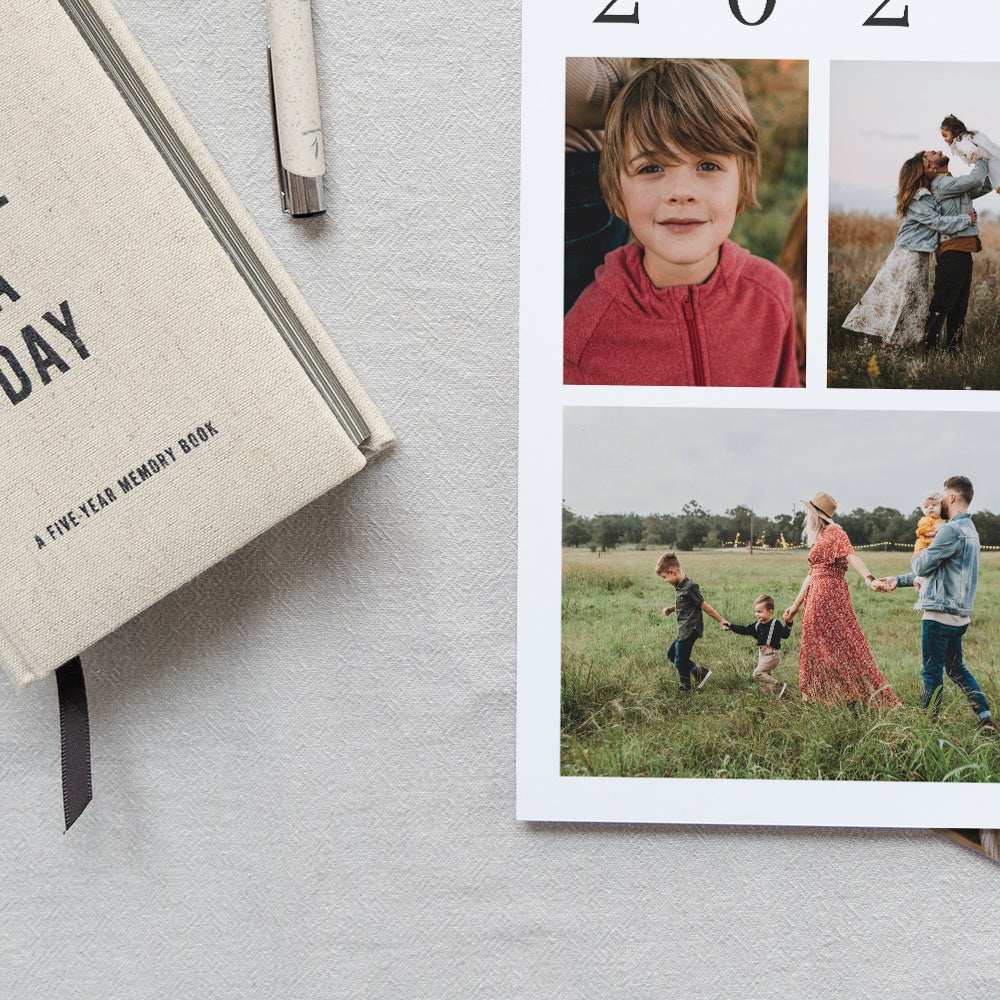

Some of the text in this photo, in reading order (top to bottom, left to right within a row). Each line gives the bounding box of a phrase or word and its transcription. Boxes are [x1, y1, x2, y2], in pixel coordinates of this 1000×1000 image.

[0, 299, 91, 407] DAY
[34, 420, 219, 550] A FIVE-YEAR MEMORY BOOK
